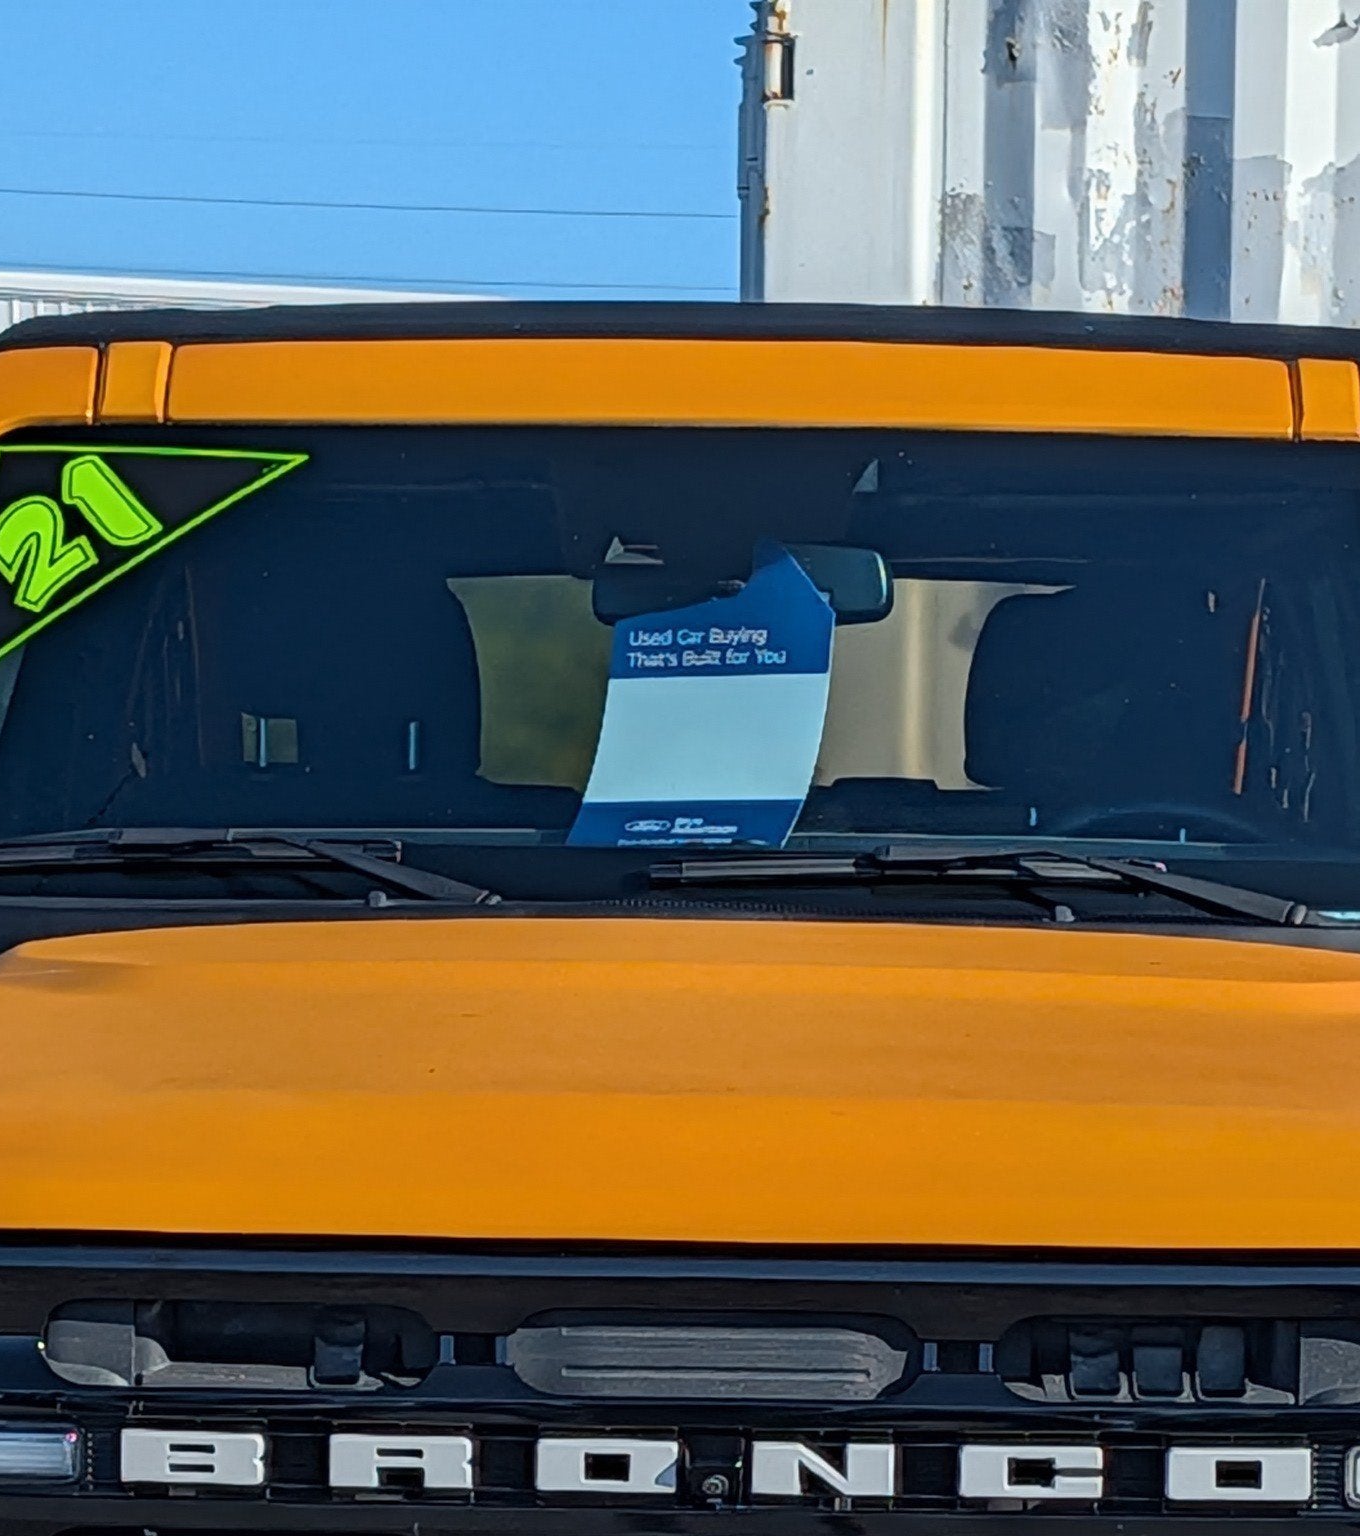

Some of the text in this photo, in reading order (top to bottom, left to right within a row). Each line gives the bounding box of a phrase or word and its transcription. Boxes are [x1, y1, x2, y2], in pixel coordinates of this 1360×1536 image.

[629, 626, 767, 646] Used Car Buying
[626, 648, 786, 668] That's Built for You
[120, 1428, 1311, 1500] BRONCO
